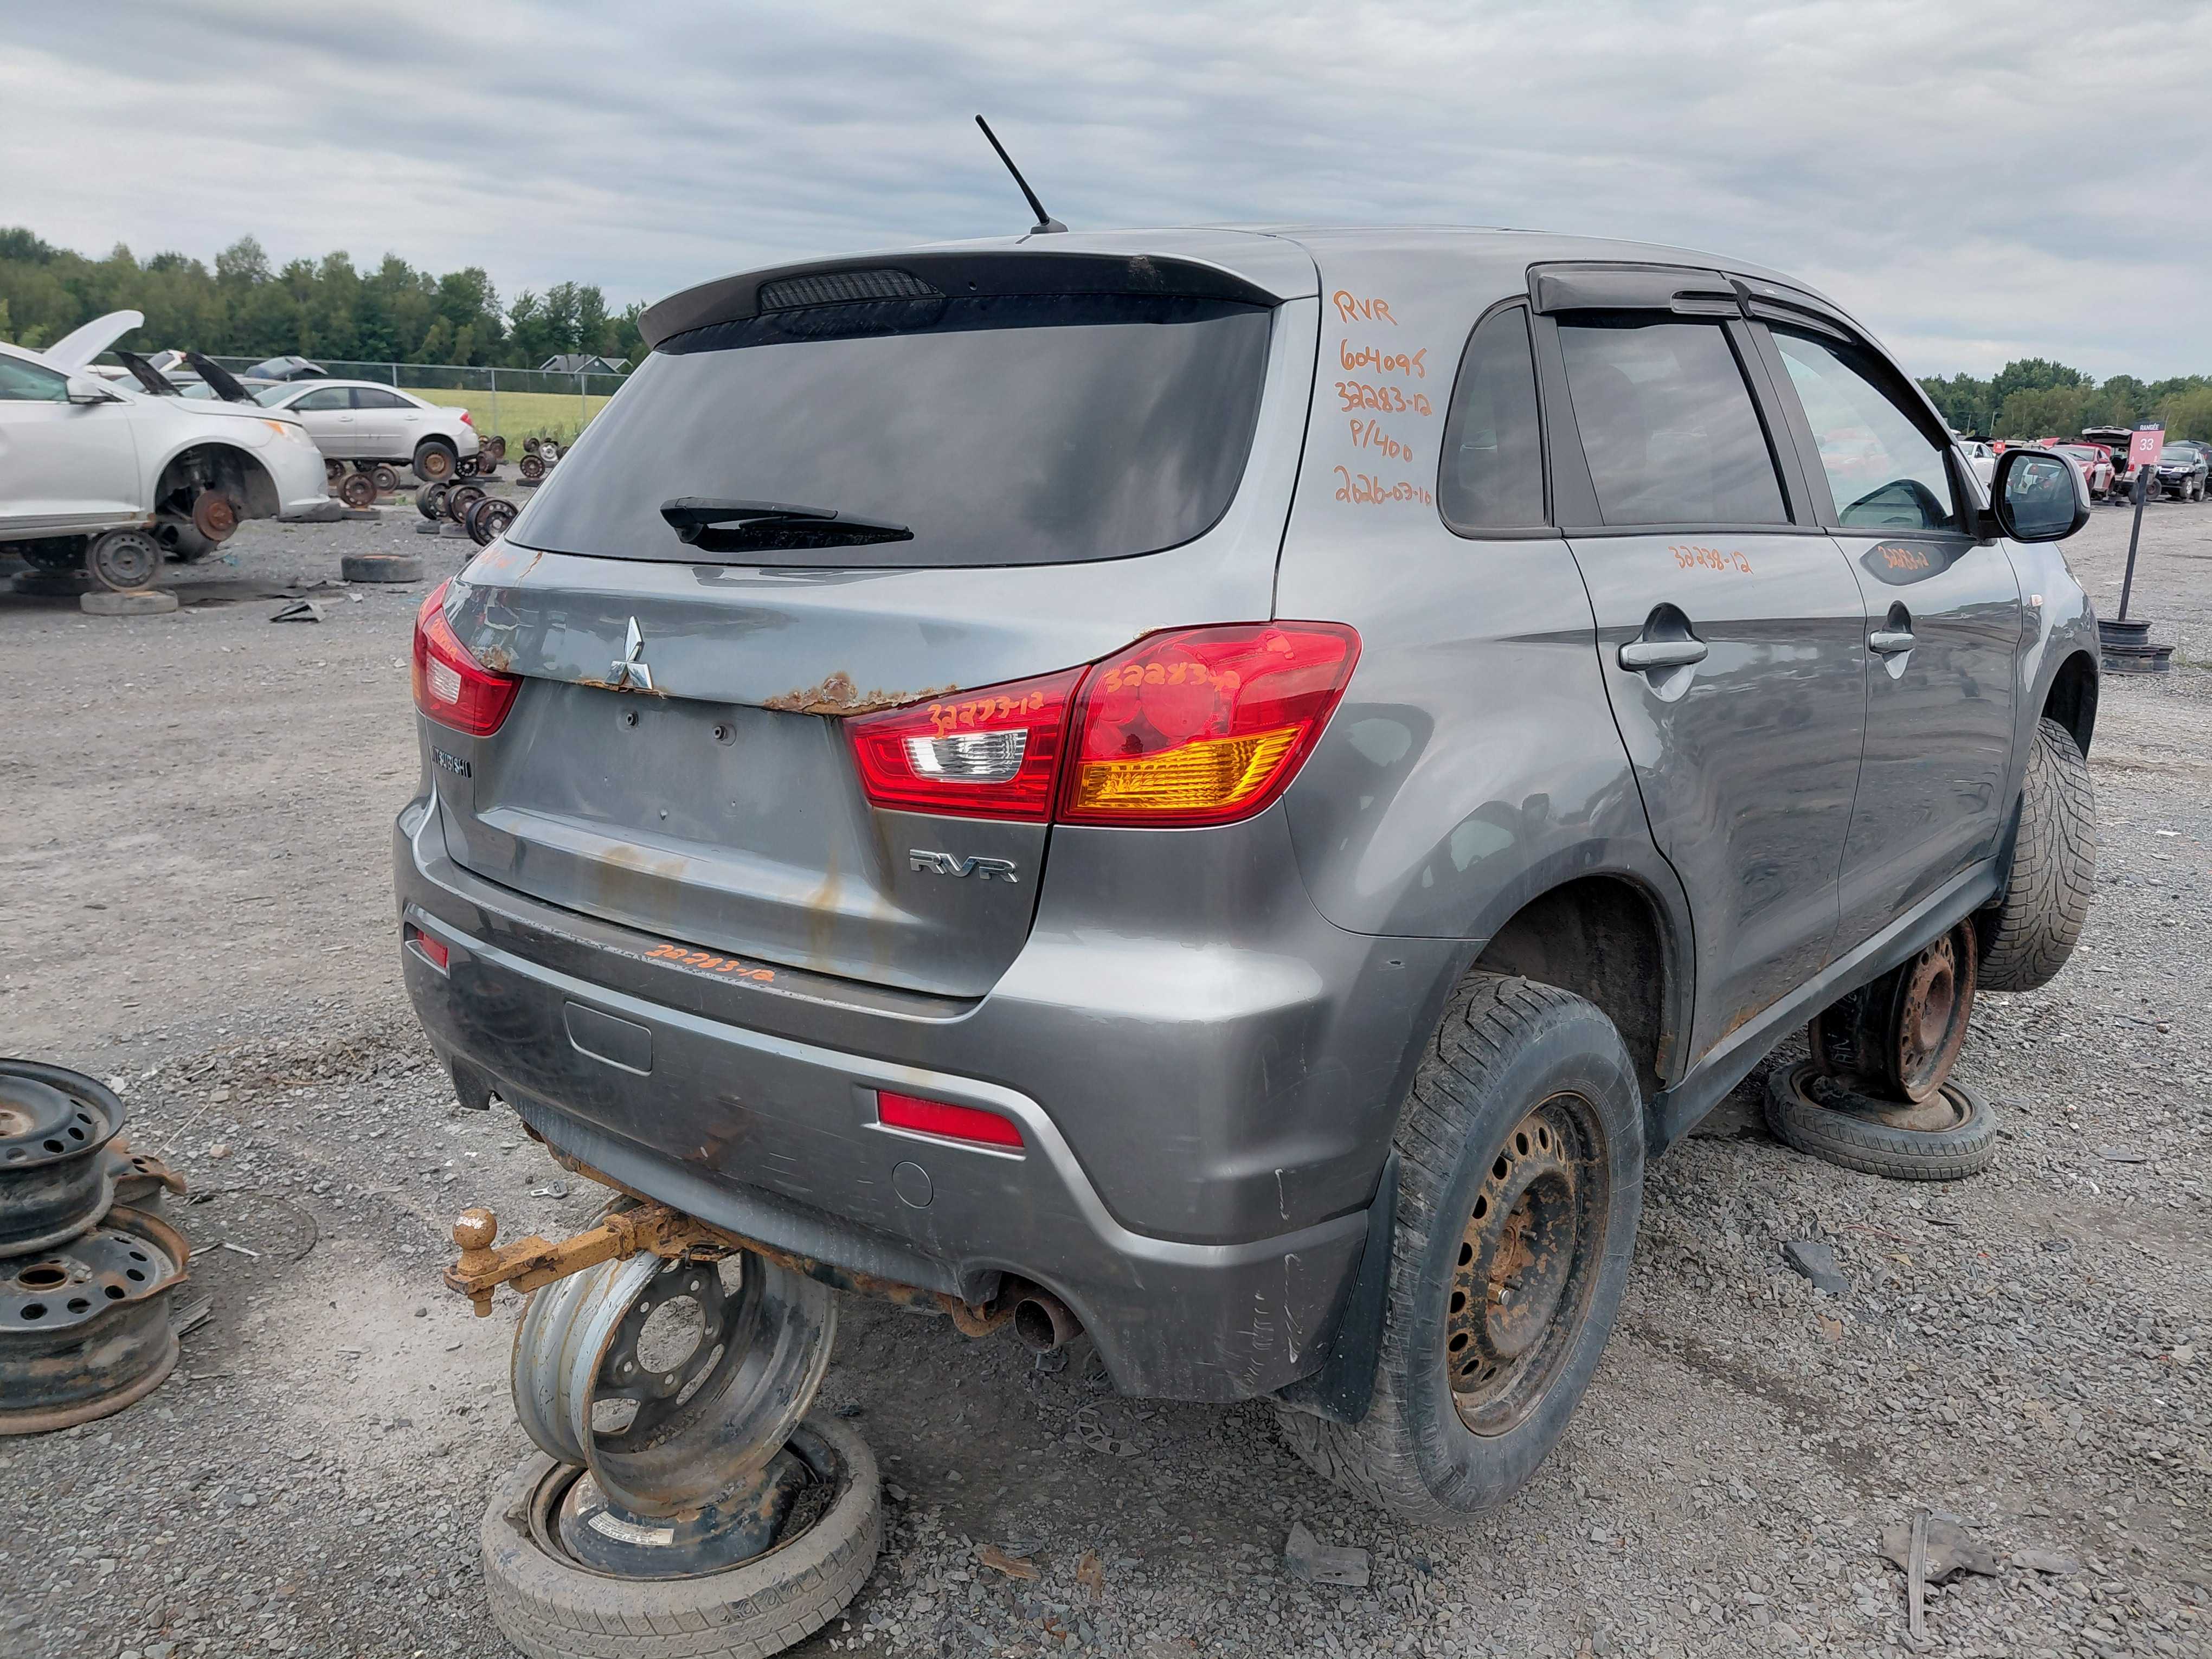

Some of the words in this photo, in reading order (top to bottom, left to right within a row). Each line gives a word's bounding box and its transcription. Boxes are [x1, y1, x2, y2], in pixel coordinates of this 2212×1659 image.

[1333, 290, 1399, 325] RVR
[2139, 438, 2154, 451] 33
[909, 848, 1019, 883] RVR
